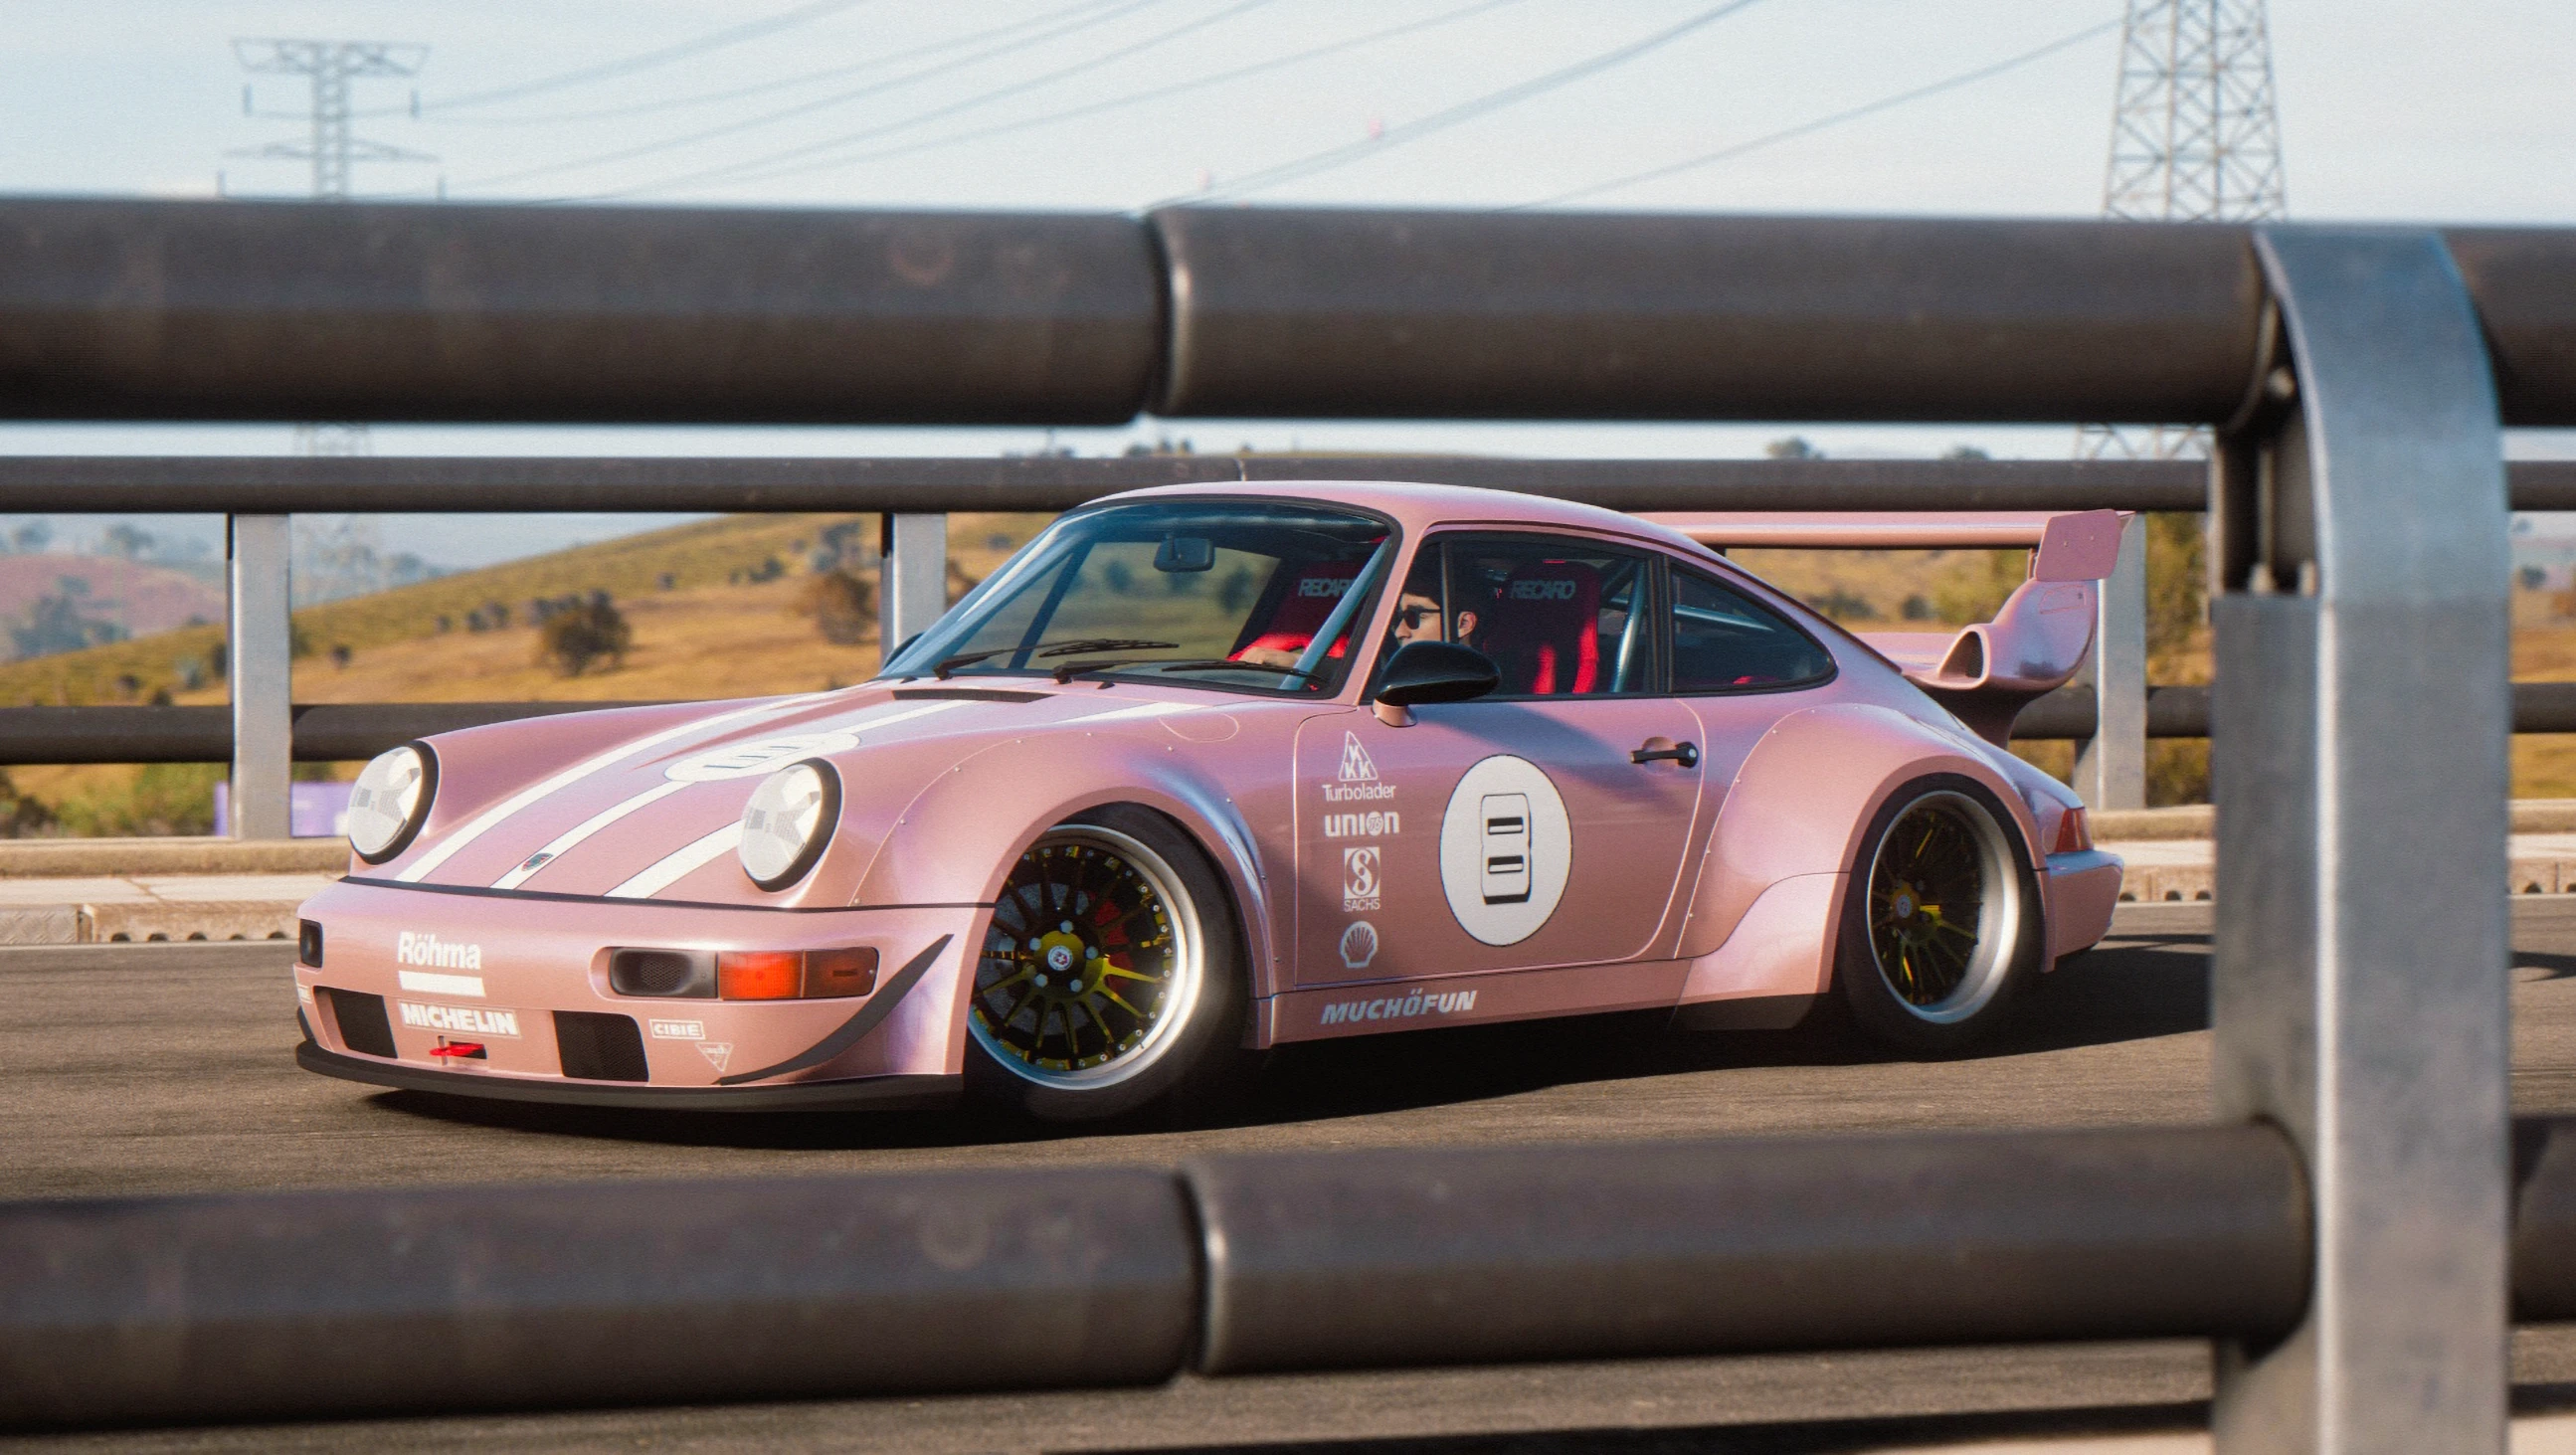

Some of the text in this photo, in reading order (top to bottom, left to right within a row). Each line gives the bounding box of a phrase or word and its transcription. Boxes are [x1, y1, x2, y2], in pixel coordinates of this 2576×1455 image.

[1298, 578, 1355, 597] RECAR
[1509, 580, 1576, 599] RECARO
[1322, 782, 1396, 802] Turbolader
[1344, 897, 1380, 912] SACHS
[398, 931, 481, 970] Röhma
[1320, 988, 1478, 1025] MUCHÖFUN
[400, 1001, 519, 1036] MICHELIN
[652, 1021, 702, 1037] CIBIE
